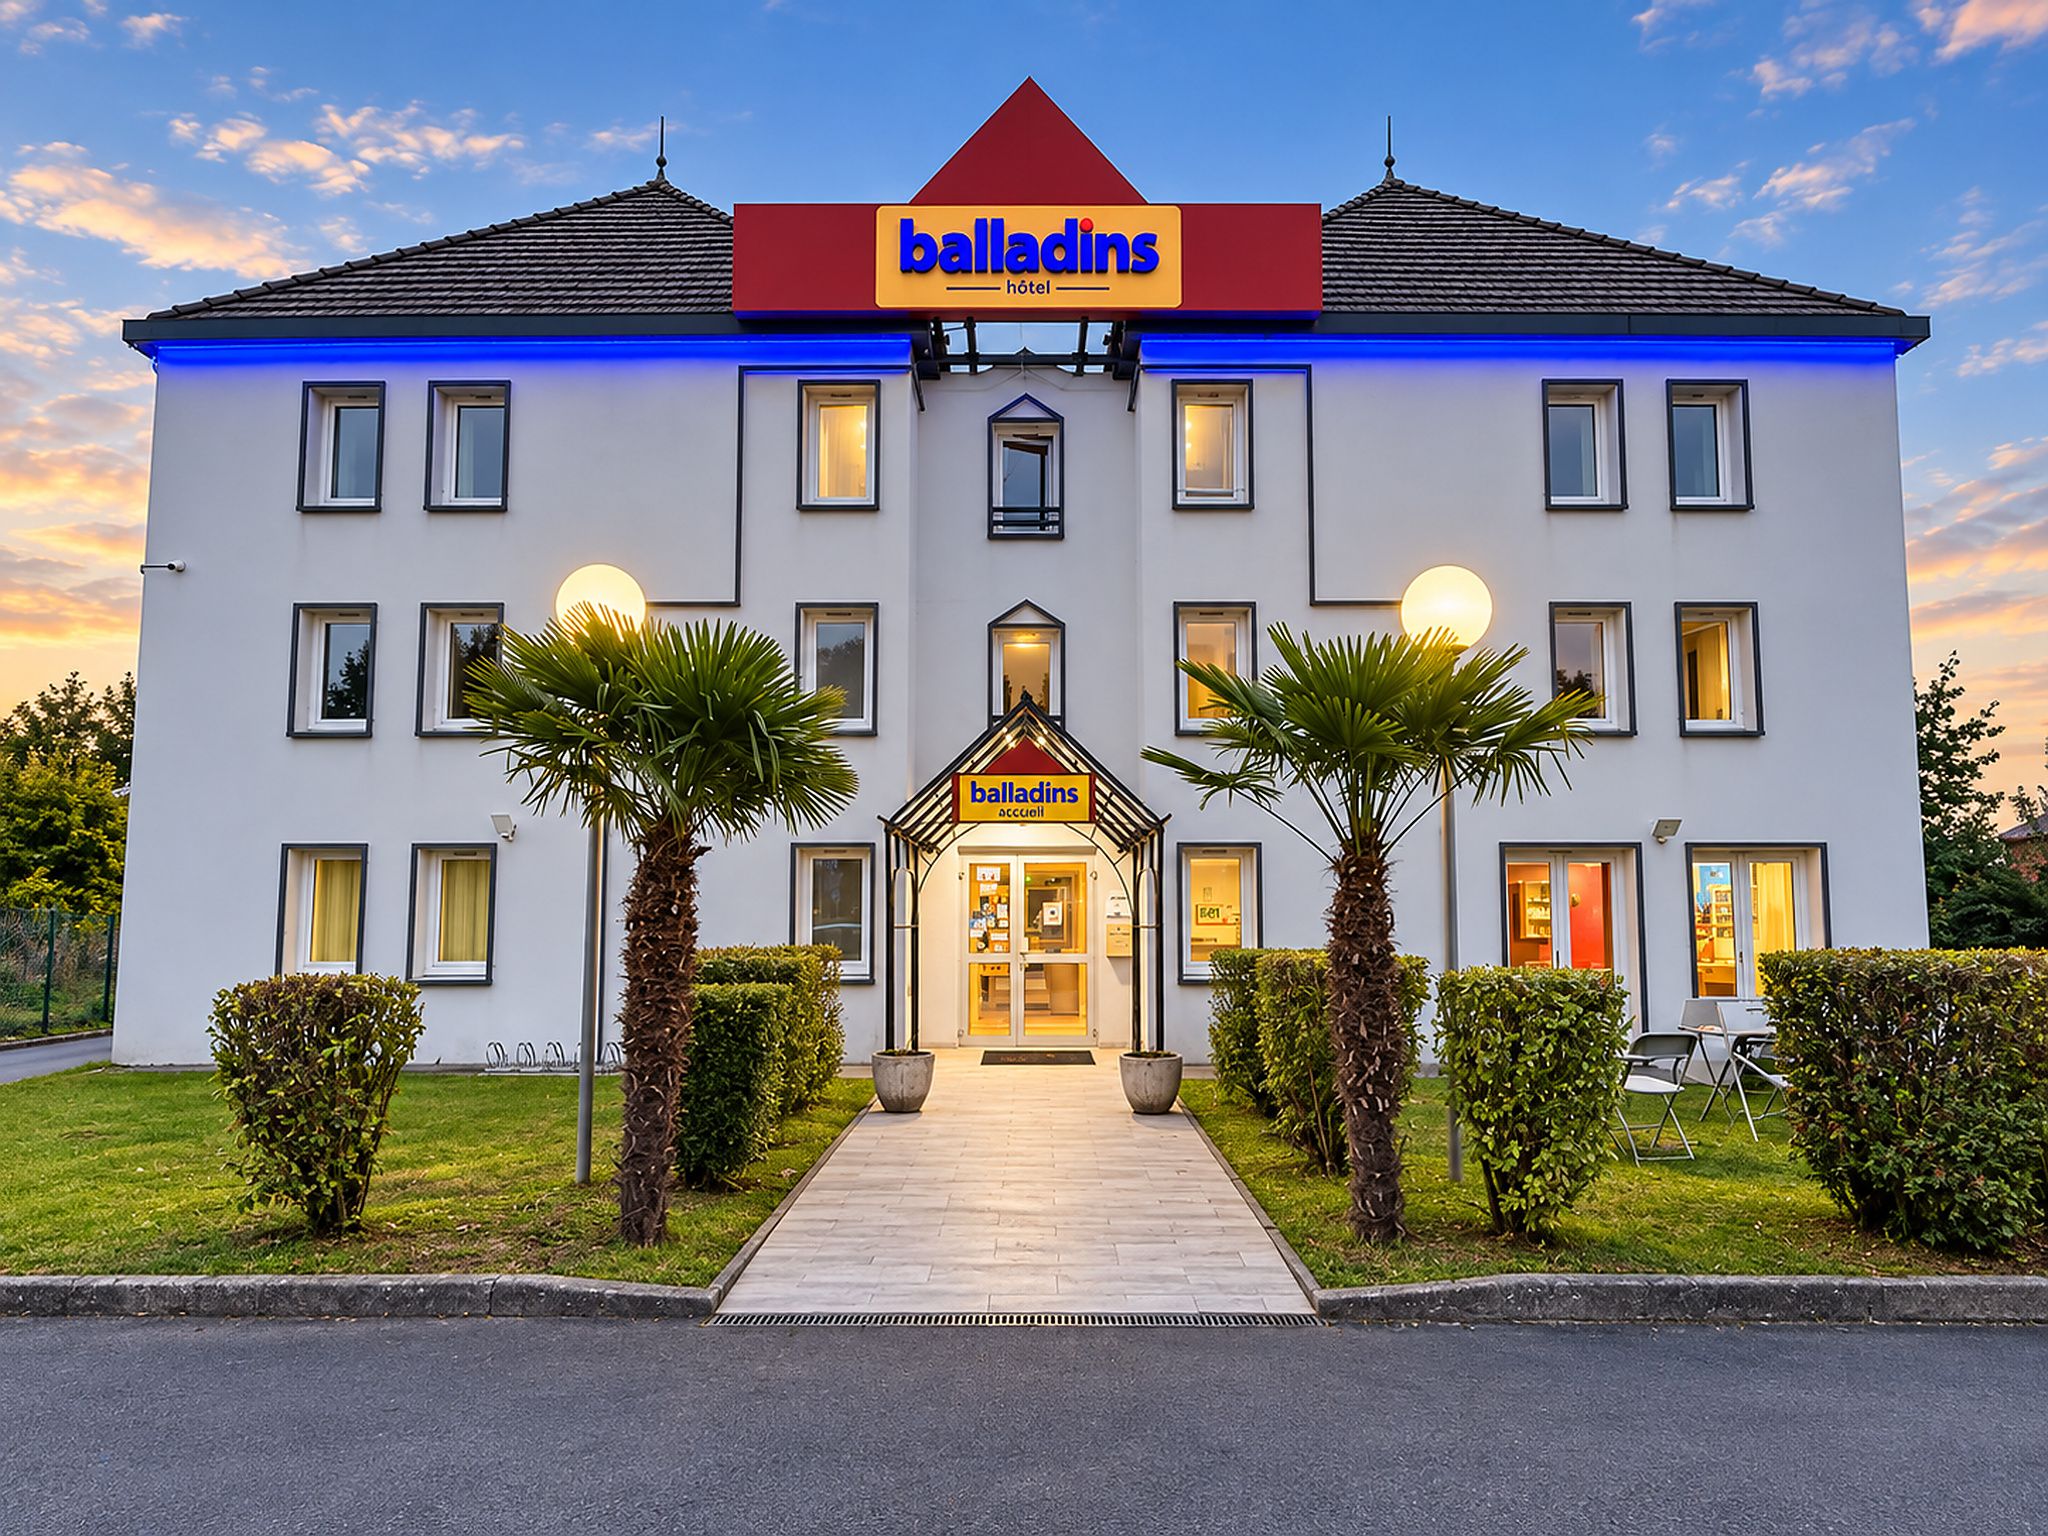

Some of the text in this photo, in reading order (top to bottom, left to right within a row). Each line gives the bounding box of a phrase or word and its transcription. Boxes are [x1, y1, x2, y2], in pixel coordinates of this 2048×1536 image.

[899, 217, 1160, 274] balladins
[1006, 280, 1051, 295] hôtel
[970, 780, 1079, 804] balladins
